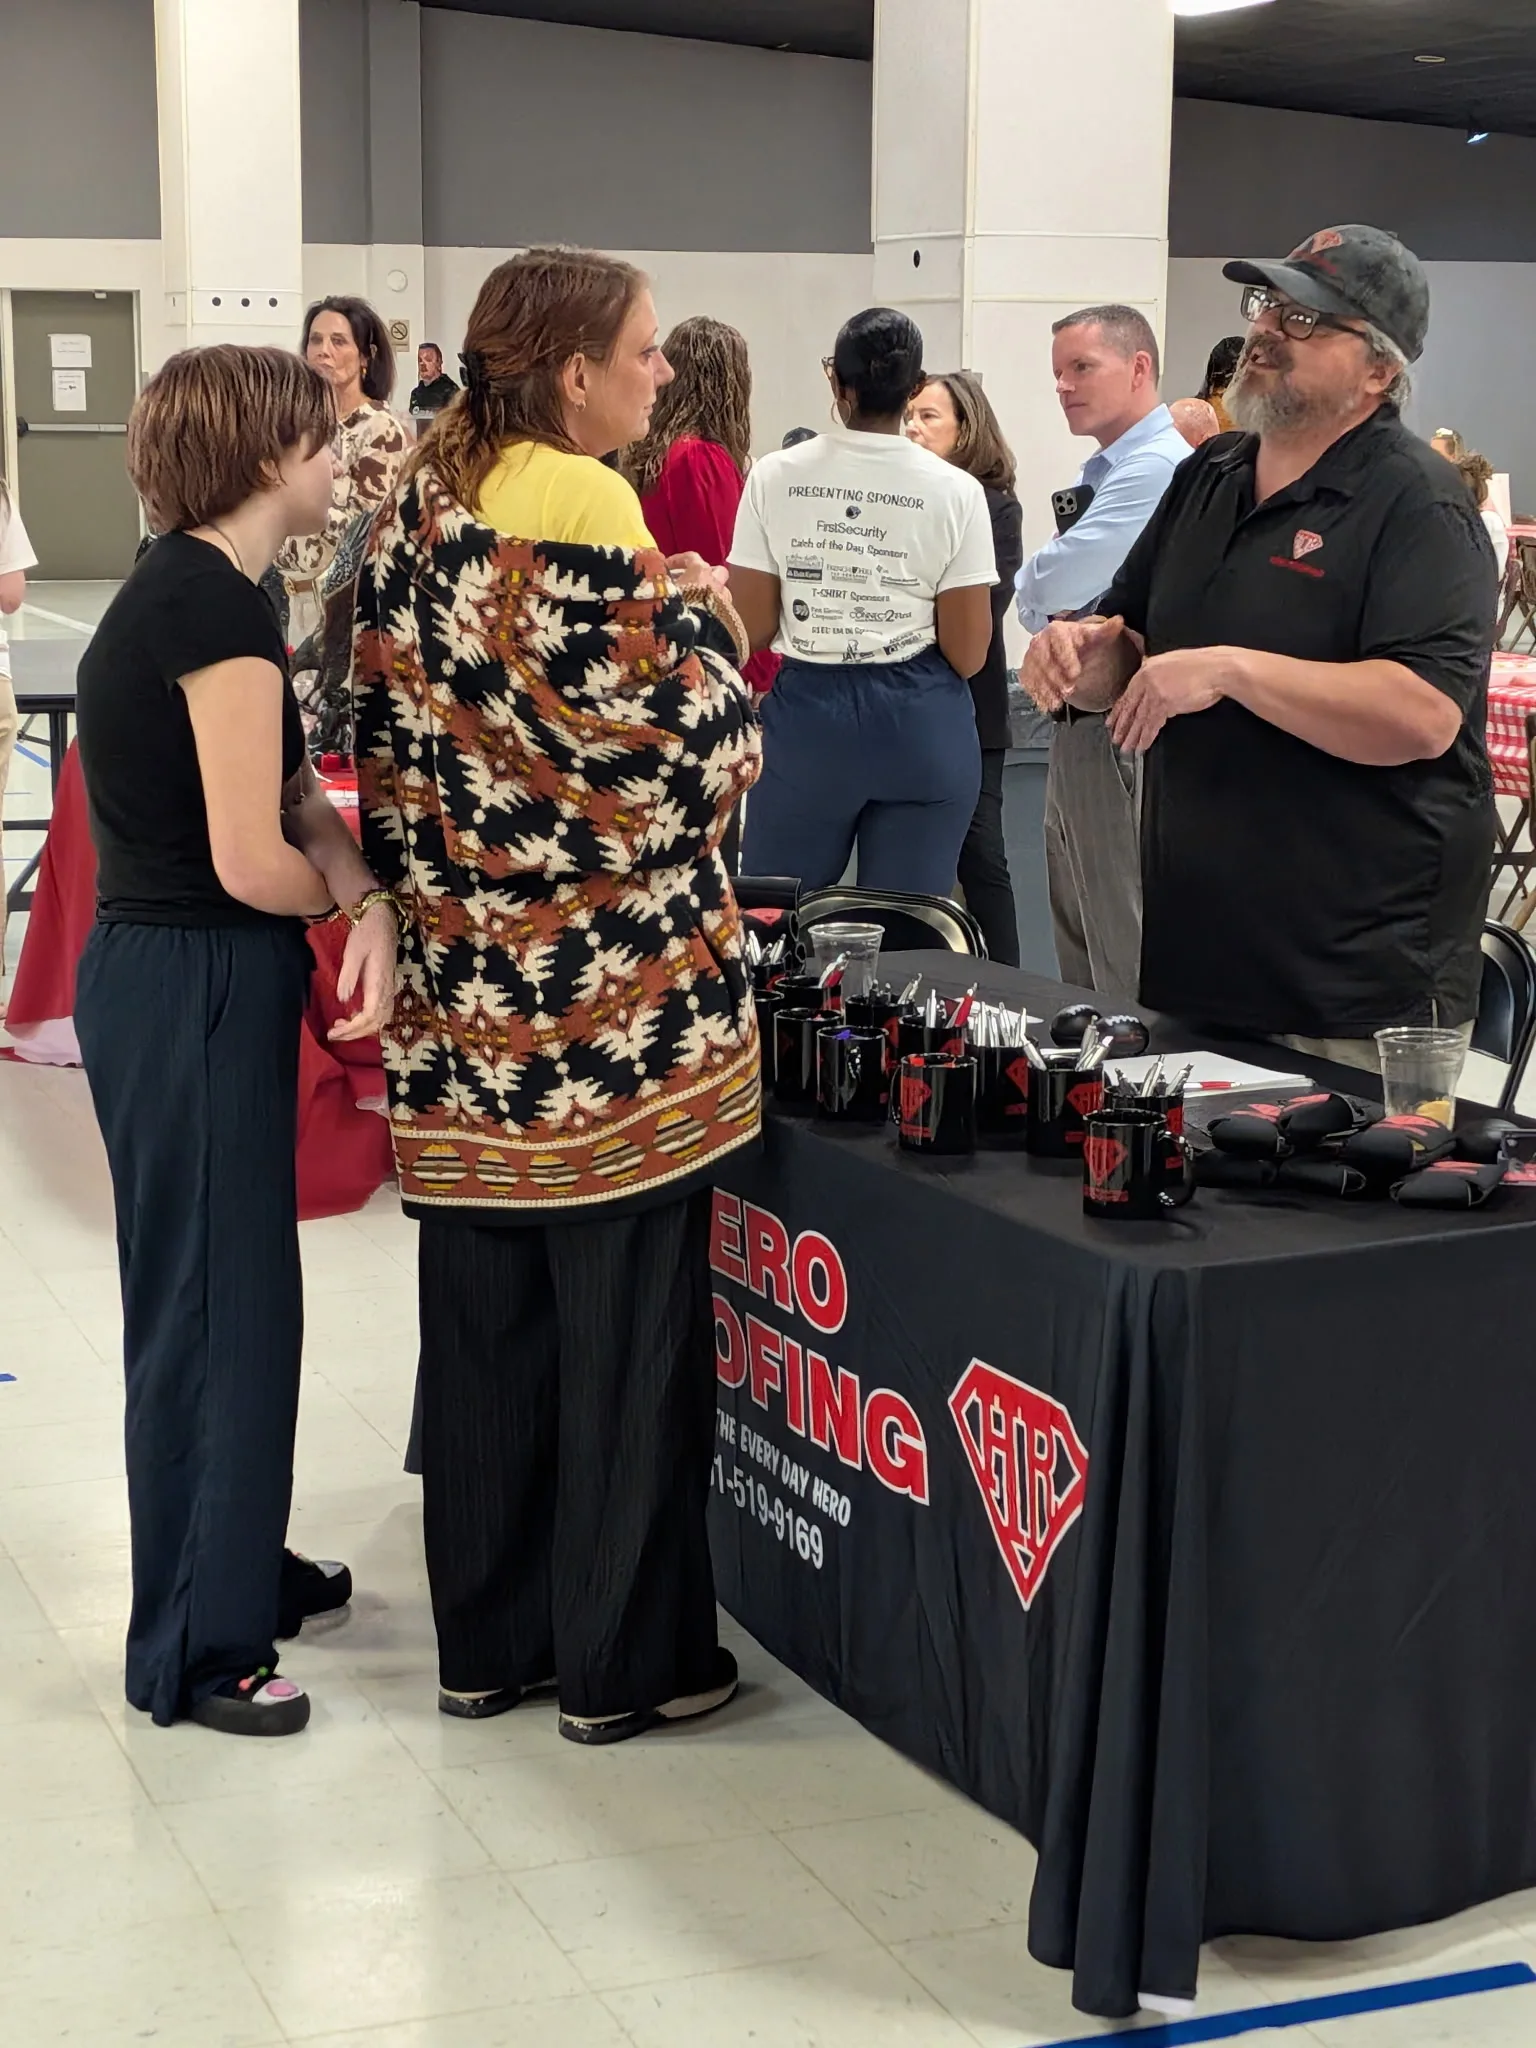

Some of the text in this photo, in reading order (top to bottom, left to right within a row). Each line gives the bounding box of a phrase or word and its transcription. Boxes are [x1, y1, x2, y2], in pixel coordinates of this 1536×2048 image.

[788, 486, 925, 510] PRESENTING SPONSOR
[816, 520, 887, 541] FirstSecurity
[791, 538, 908, 559] Catch of the Day Sponsors
[812, 588, 890, 602] T-SHIRT Sponsors
[740, 1423, 780, 1476] EVERY
[781, 1454, 810, 1499] DAY
[812, 1475, 852, 1528] HERO
[710, 1453, 824, 1570] 1-519-9169
